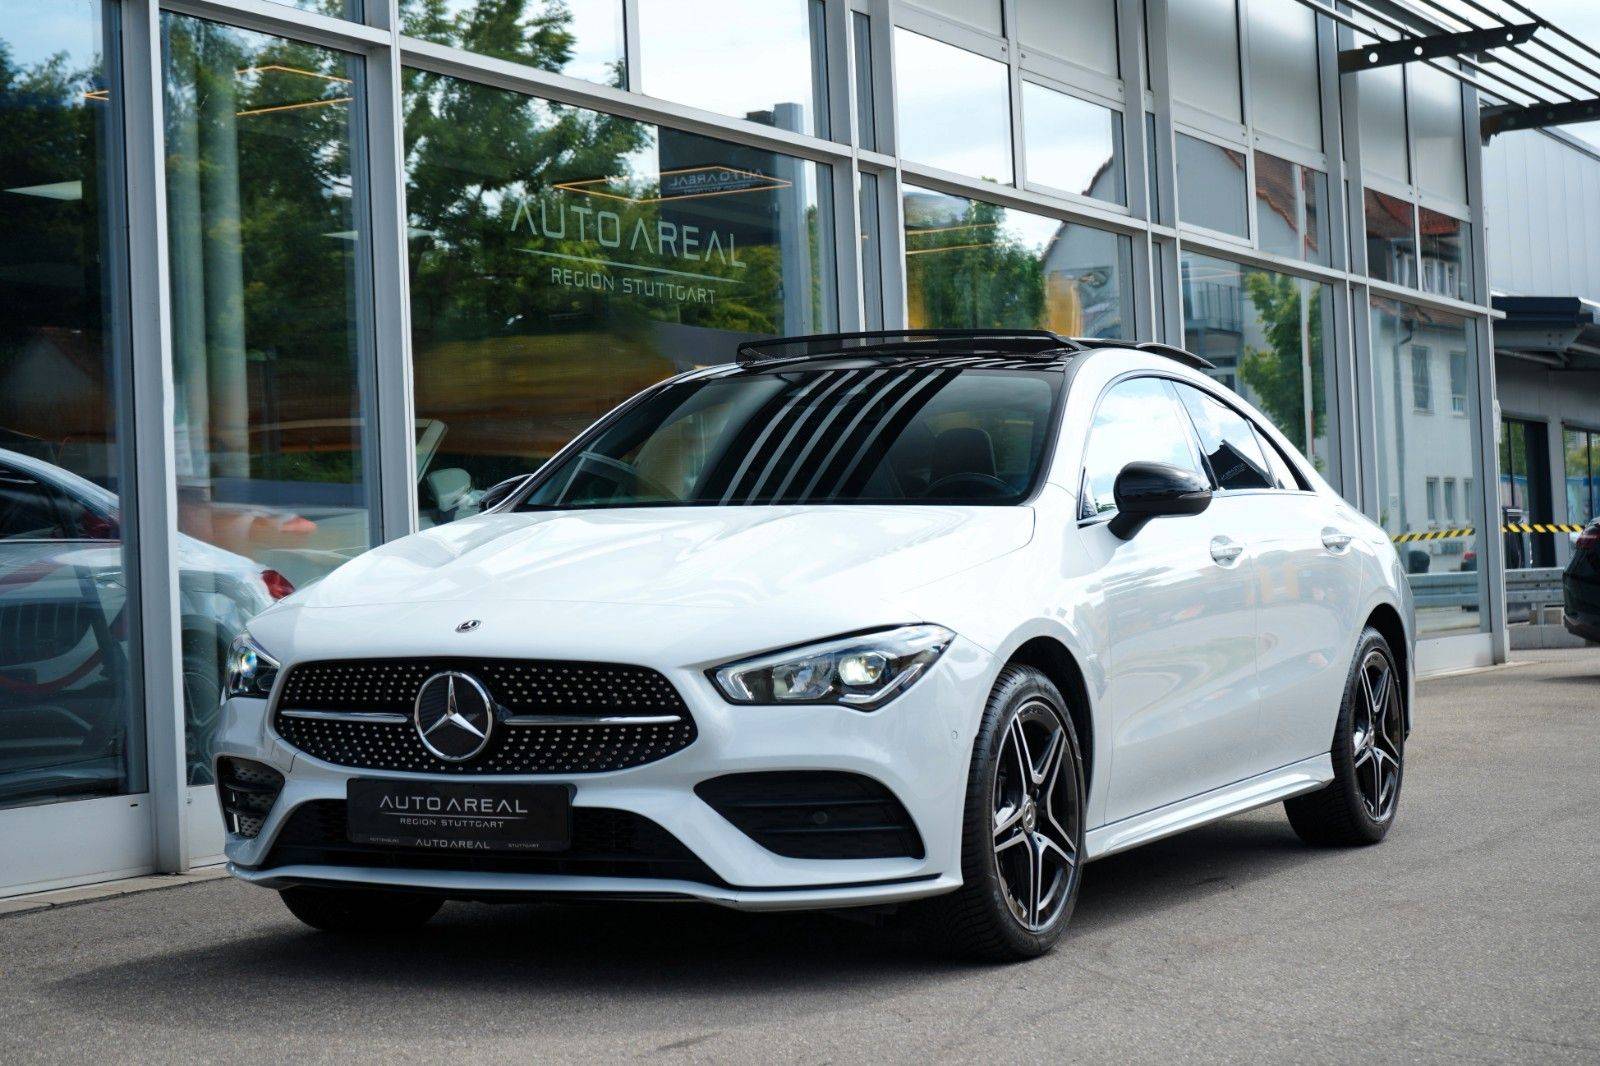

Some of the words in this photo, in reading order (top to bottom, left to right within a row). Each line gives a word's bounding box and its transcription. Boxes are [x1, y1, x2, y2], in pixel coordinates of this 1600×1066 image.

[551, 267, 615, 290] REGION
[622, 279, 716, 305] STUTTGART
[400, 817, 437, 827] REGION
[441, 819, 504, 829] STUTTGART
